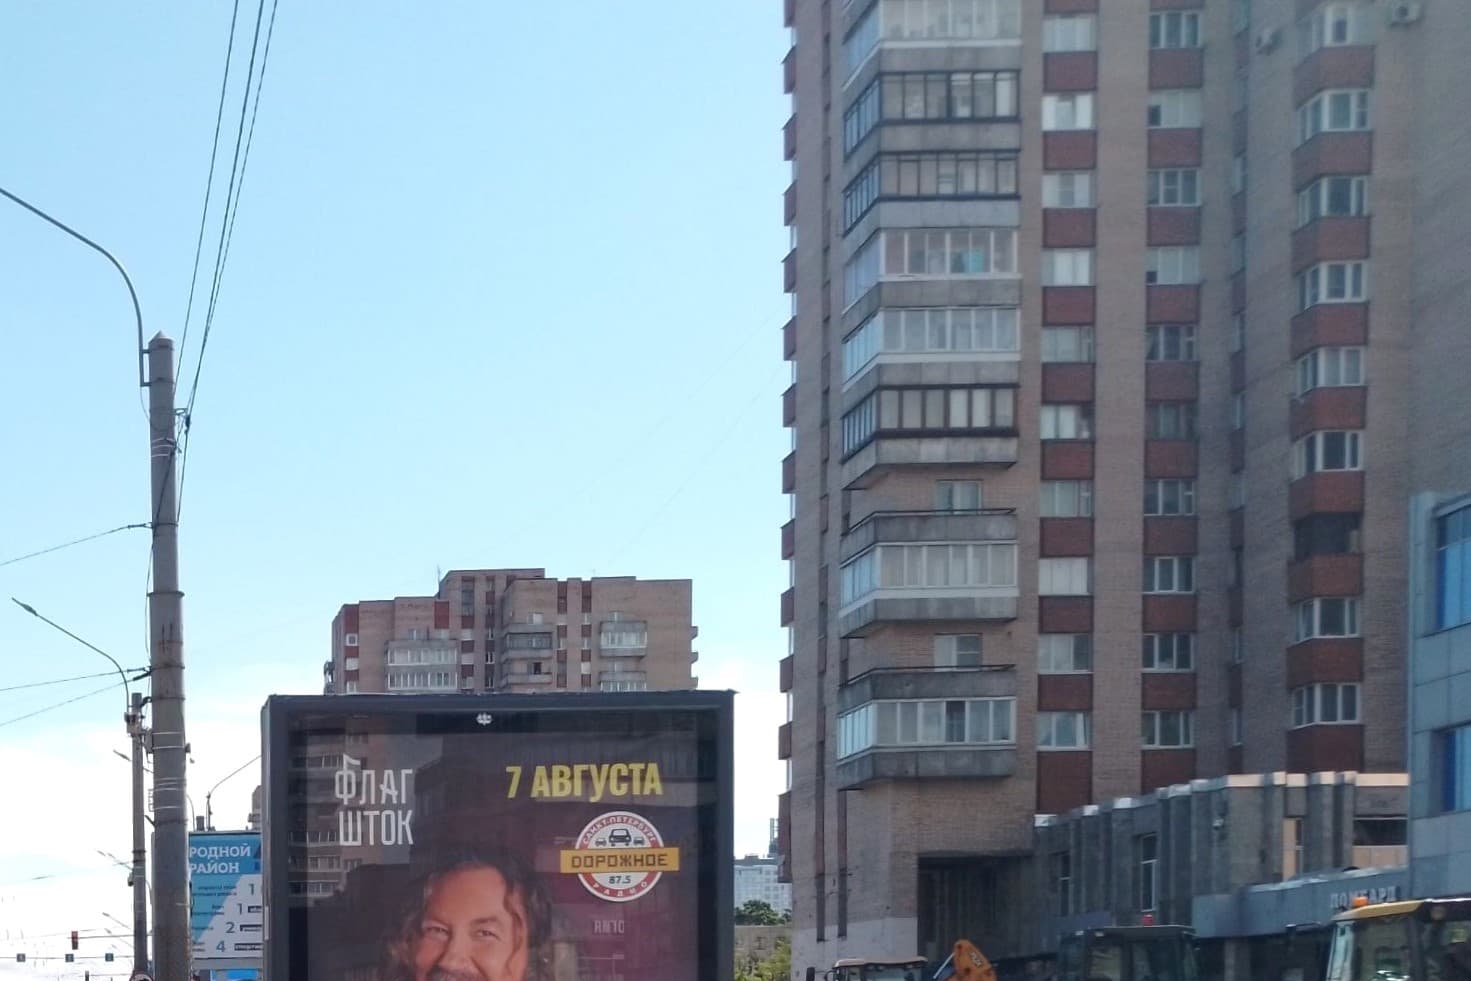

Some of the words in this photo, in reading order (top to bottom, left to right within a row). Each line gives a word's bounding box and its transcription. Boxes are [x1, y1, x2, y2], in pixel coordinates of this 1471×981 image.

[335, 754, 413, 805] ФЛАГ
[505, 766, 522, 799] 7
[530, 763, 663, 803] АВГУСТА
[339, 810, 414, 846] ШТОК
[190, 843, 251, 859] РОДНОЙ
[190, 860, 240, 874] РАЙОН
[608, 875, 631, 885] 87.5
